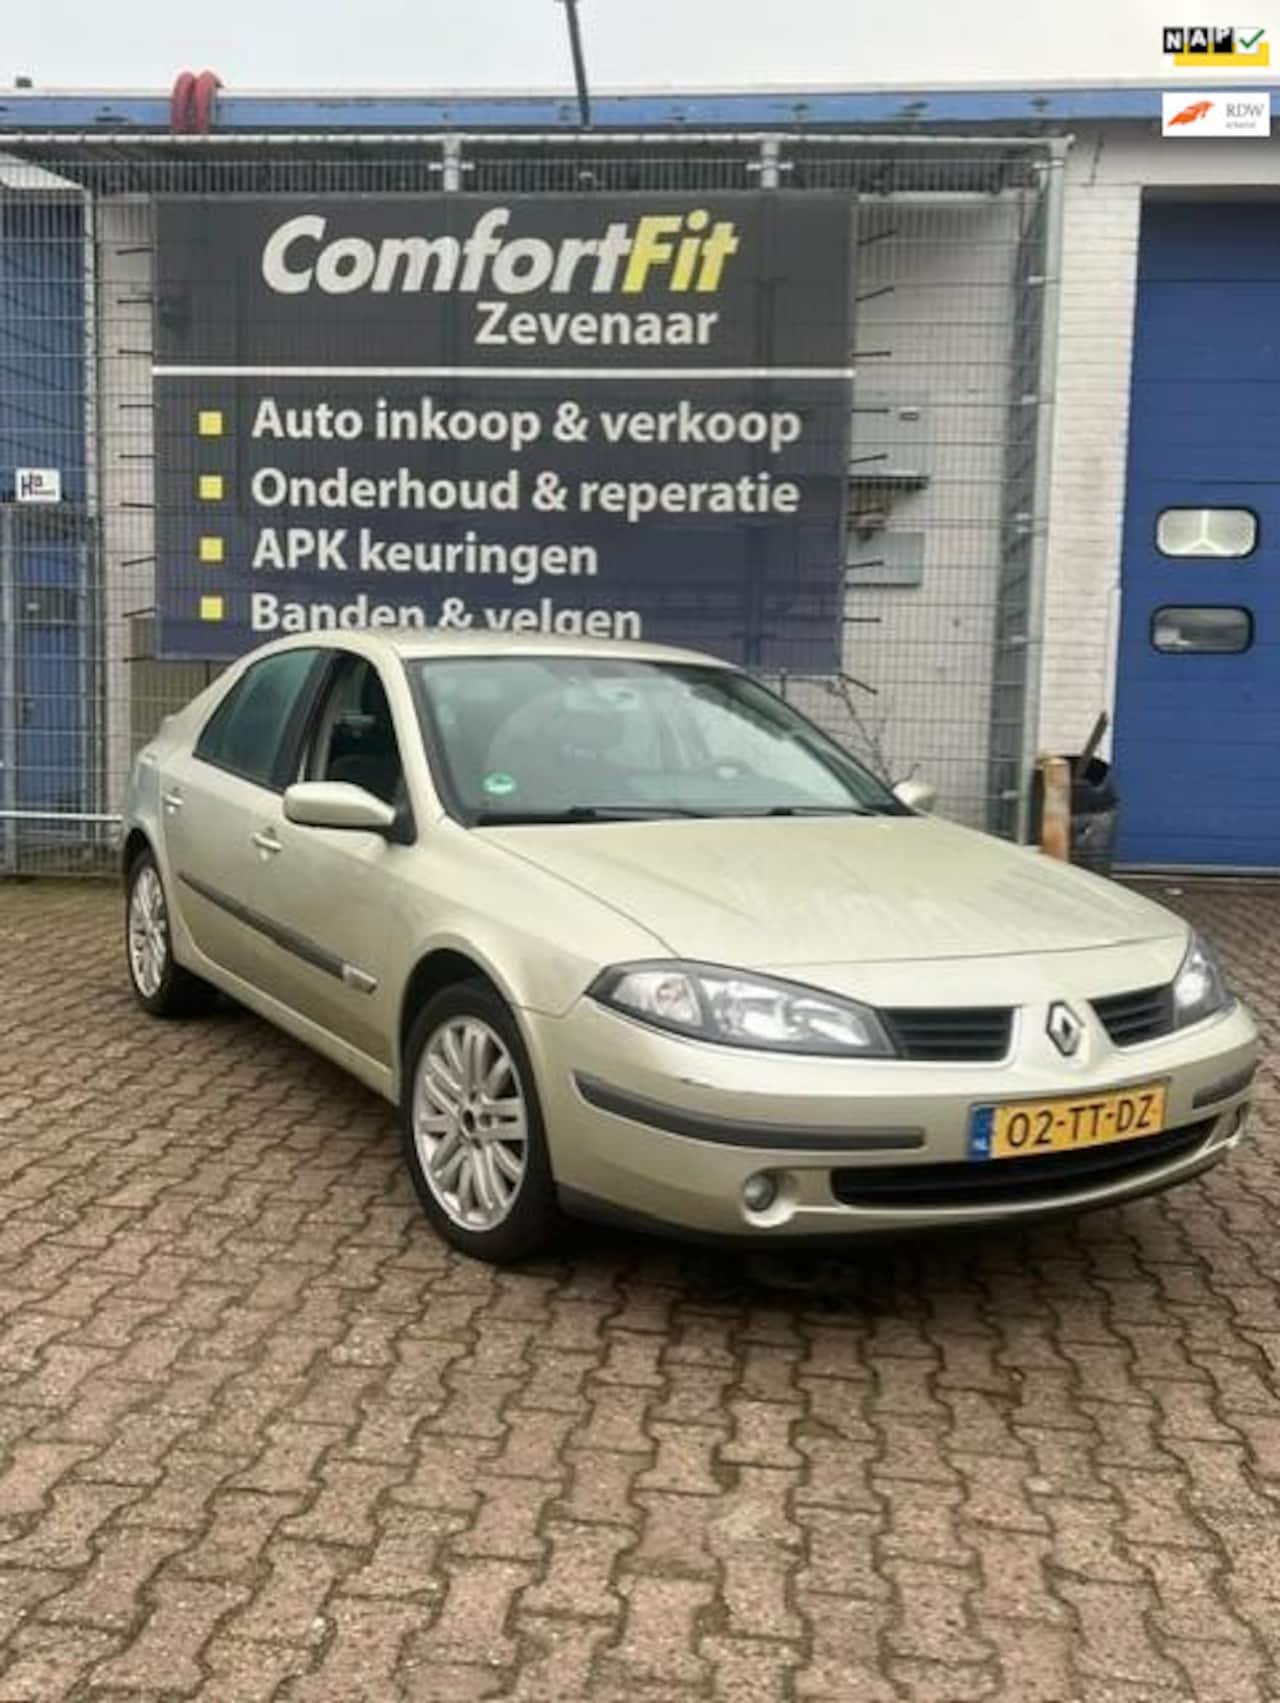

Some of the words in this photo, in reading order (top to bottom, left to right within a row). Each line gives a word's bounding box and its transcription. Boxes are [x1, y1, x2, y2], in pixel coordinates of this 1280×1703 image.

[262, 207, 739, 294] ComfortFit
[474, 301, 719, 345] Zevenaar
[252, 397, 363, 440] Auto
[376, 396, 541, 451] inkoop
[553, 401, 589, 442] &
[600, 400, 802, 453] verkoop
[251, 467, 519, 510] Onderhoud
[532, 471, 568, 511] &
[579, 472, 801, 522] reperatie
[252, 528, 348, 571] APK
[359, 528, 598, 584] keuringen
[251, 592, 425, 632] Banden
[438, 597, 474, 628] &
[1006, 1093, 1154, 1148] 02-TT-DZ
